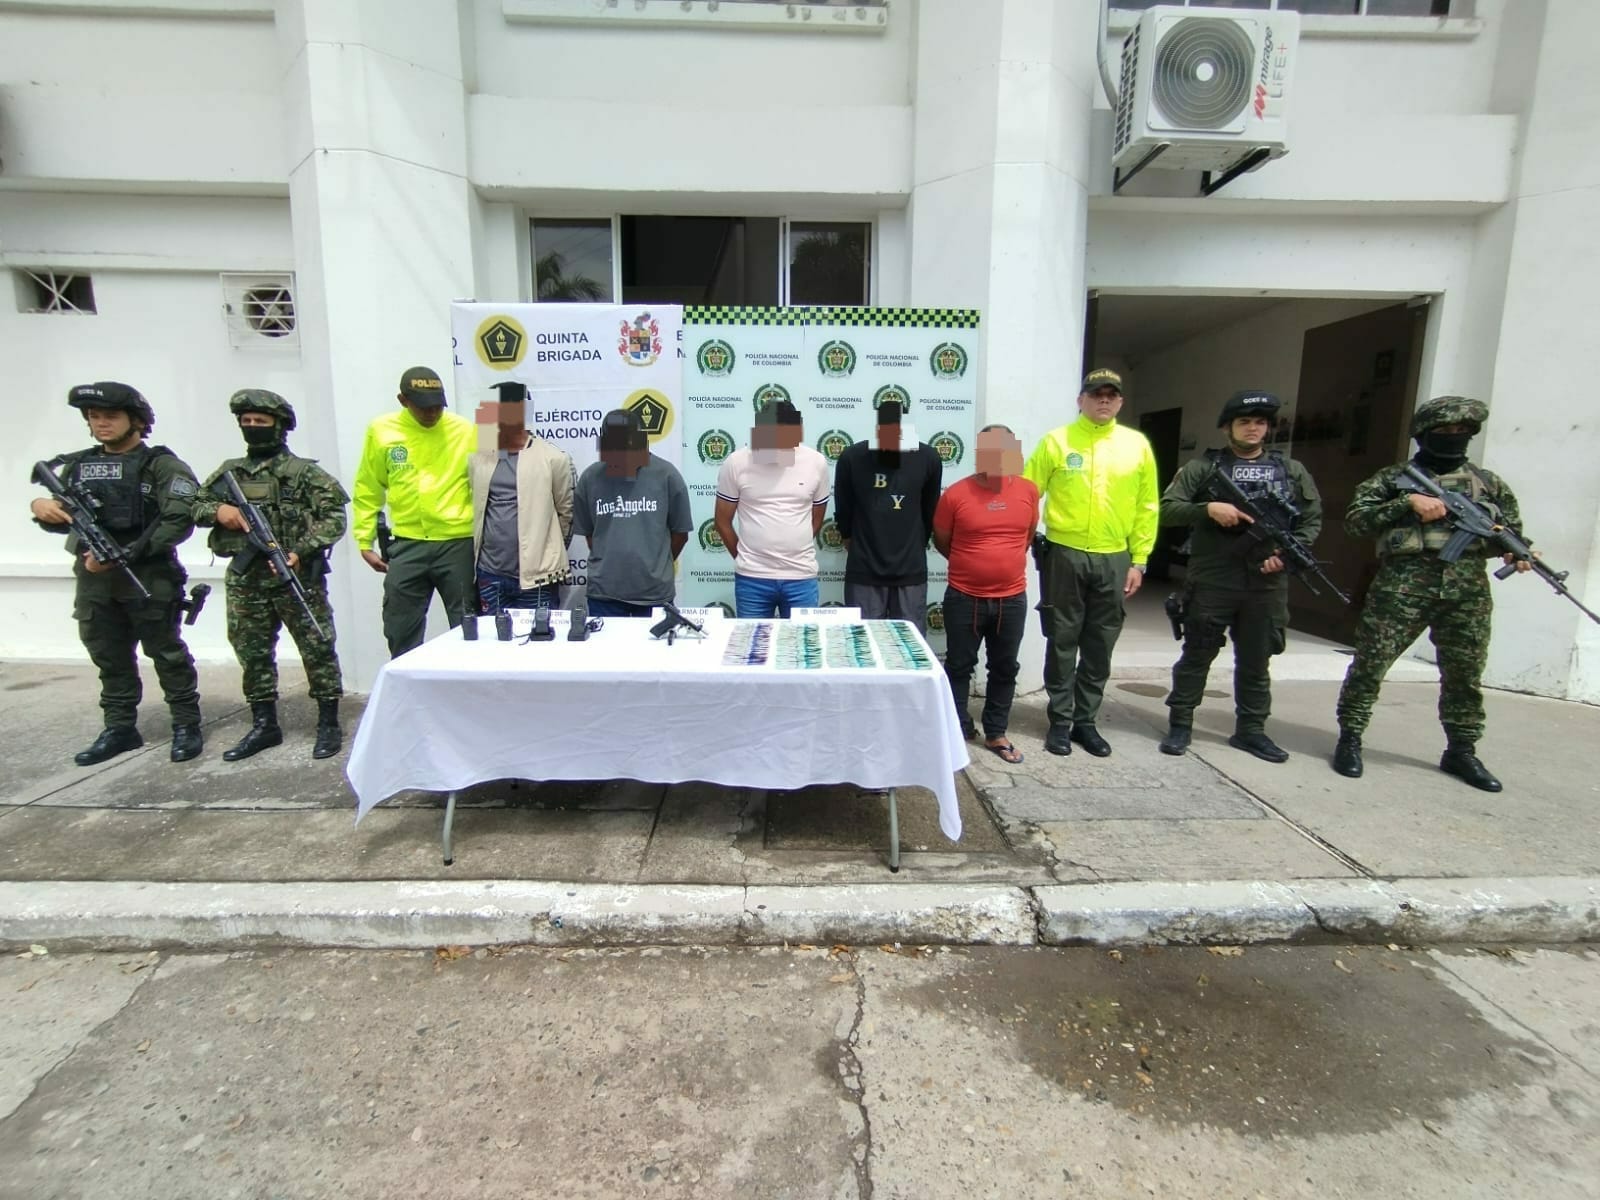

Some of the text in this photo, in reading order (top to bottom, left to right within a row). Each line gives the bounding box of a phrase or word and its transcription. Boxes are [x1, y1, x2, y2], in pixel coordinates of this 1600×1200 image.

[1260, 26, 1273, 86] mirage
[536, 332, 589, 345] QUINTA
[537, 349, 602, 362] BRIGADA
[535, 409, 602, 423] EJÉRCITO
[83, 464, 120, 478] GOES-H
[1235, 467, 1272, 480] GOES-H
[873, 473, 888, 488] B
[596, 495, 657, 516] Los Angeles
[890, 494, 905, 510] Y
